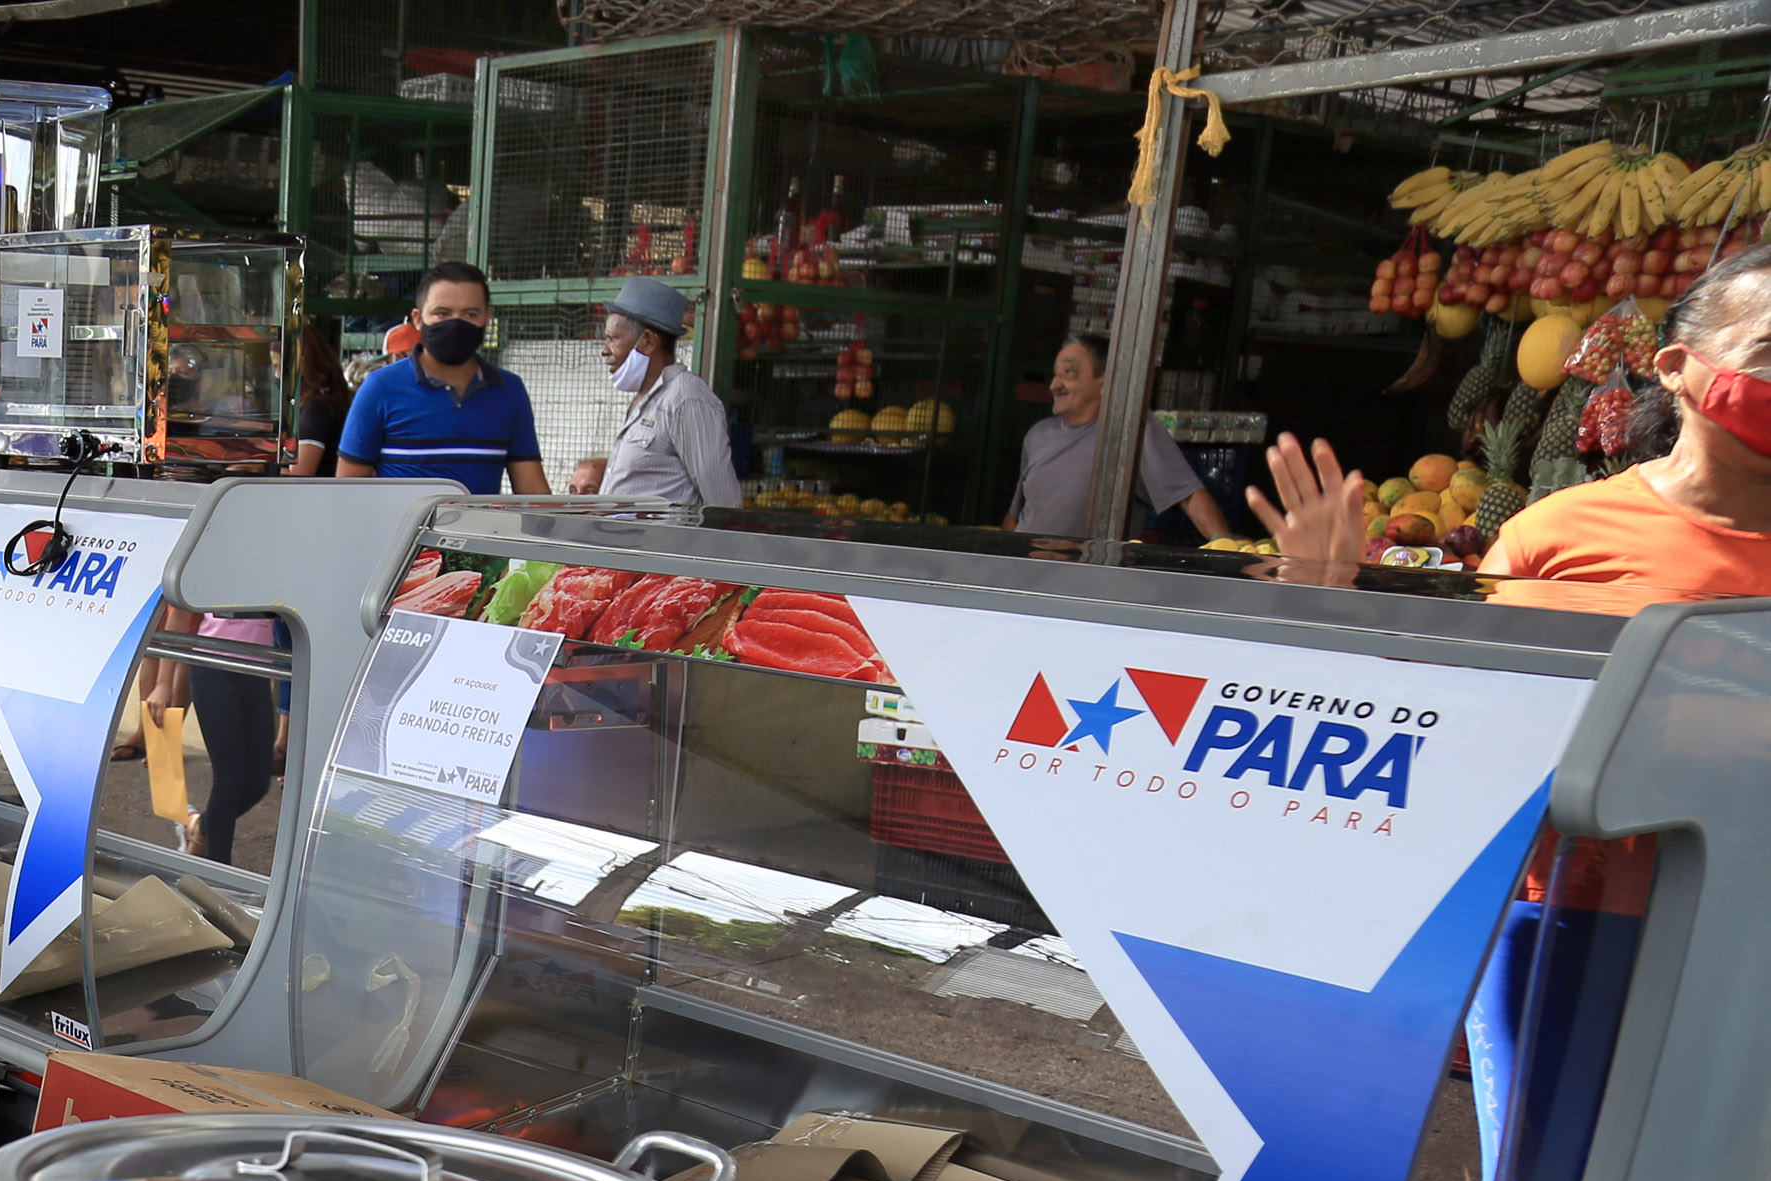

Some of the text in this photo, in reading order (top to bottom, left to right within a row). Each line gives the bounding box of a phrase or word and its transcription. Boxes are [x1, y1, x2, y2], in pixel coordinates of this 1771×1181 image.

[118, 540, 137, 552] DO
[46, 596, 56, 607] O
[65, 599, 108, 615] PARÁ
[384, 628, 431, 647] SEDAP
[465, 679, 498, 692] AÇOUGUE
[429, 699, 500, 725] WELLIGTON
[1220, 681, 1440, 729] GOVERNO DO
[399, 712, 513, 747] BRANDÃO FREITAS
[1182, 704, 1427, 810] PARÁ
[994, 747, 1396, 838] POR TODO O PARÁ
[54, 1016, 90, 1047] frilux
